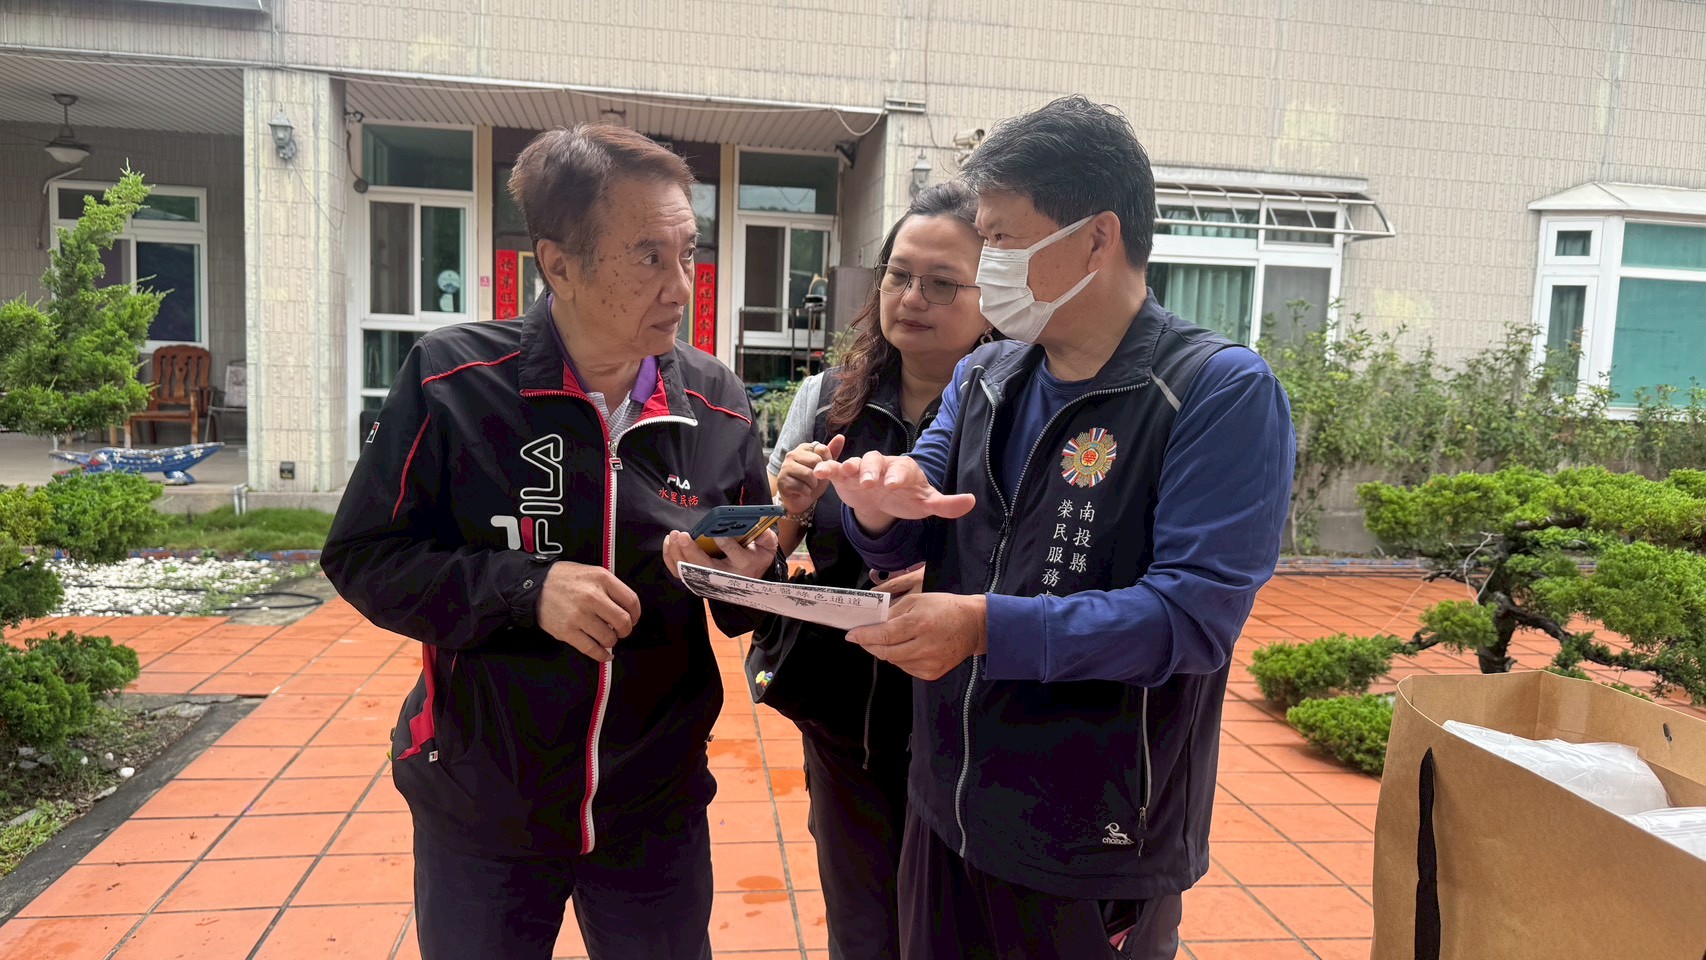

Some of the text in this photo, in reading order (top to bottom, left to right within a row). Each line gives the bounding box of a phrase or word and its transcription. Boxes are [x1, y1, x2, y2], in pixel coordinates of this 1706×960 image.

[490, 433, 564, 554] FILA
[666, 473, 691, 490] FILA
[1068, 500, 1096, 573] 南投縣
